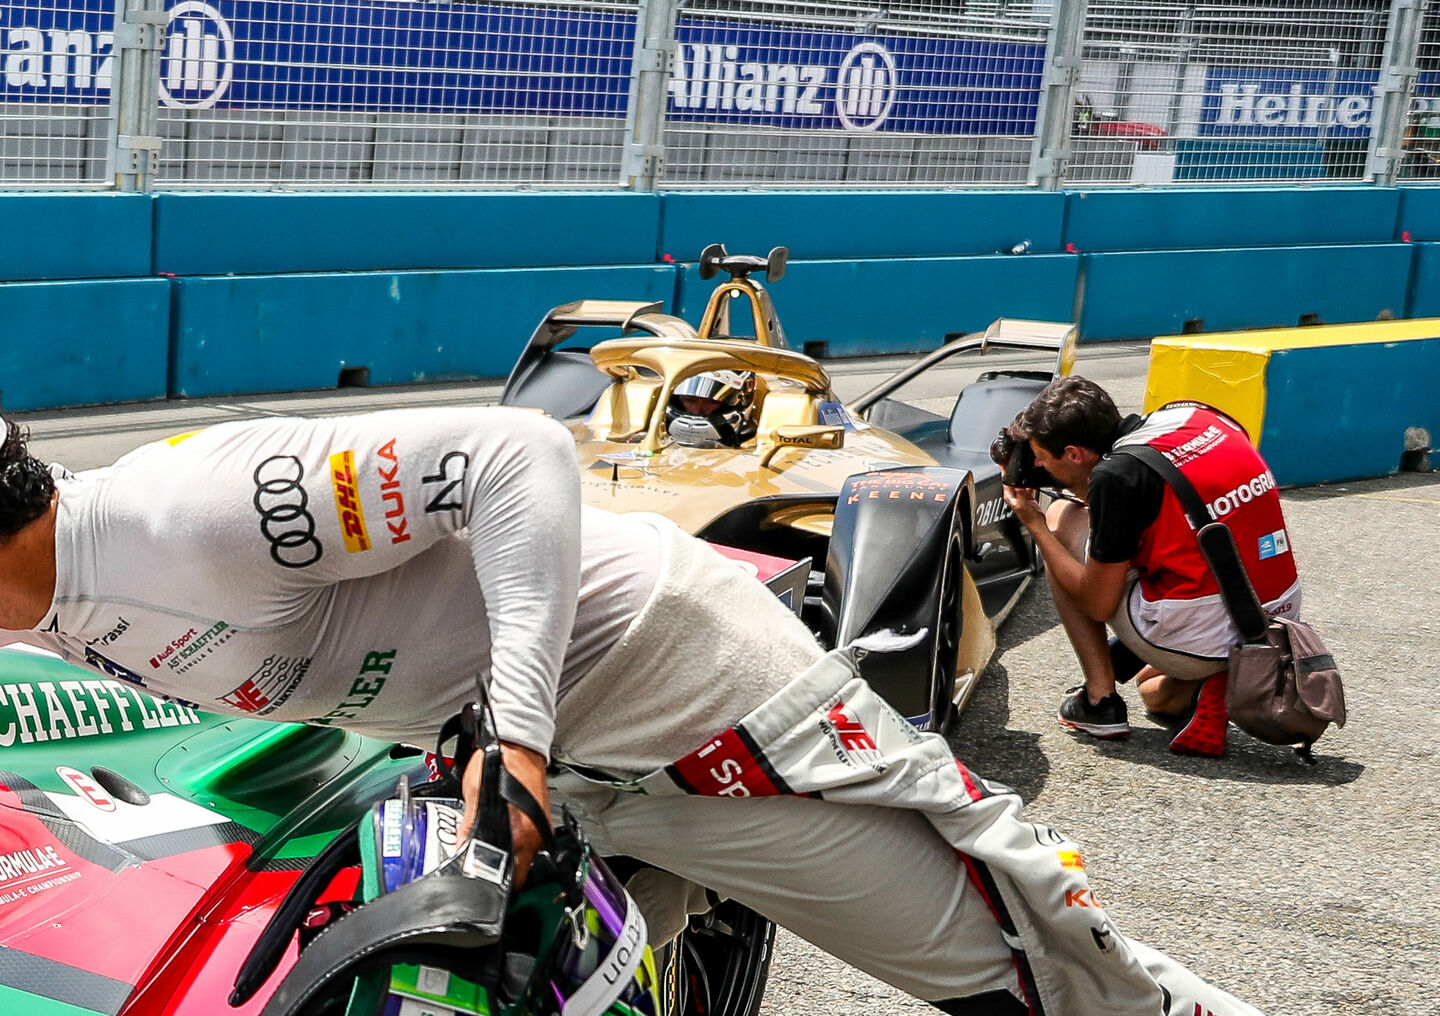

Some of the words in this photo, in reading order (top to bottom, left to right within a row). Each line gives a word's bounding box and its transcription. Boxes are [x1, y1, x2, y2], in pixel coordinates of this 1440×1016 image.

[778, 435, 812, 444] TOTAL
[377, 438, 411, 545] KUKA
[847, 490, 947, 506] KEENE
[157, 645, 175, 663] Audi
[171, 628, 198, 649] Sport
